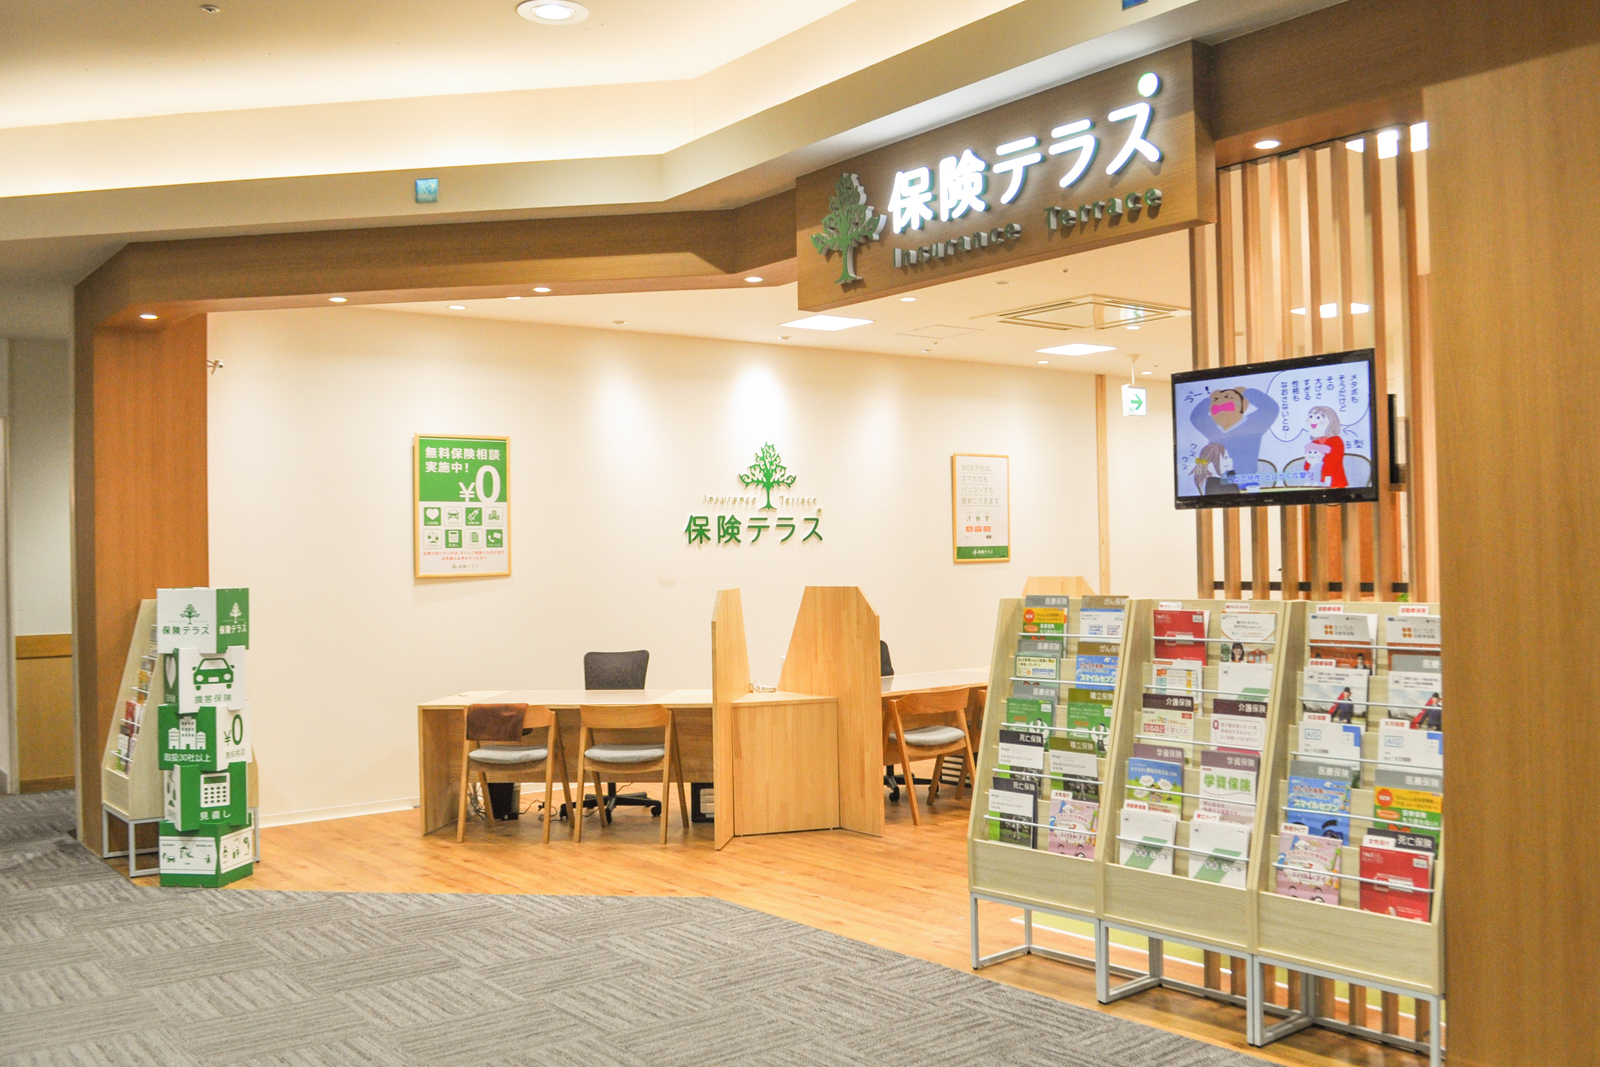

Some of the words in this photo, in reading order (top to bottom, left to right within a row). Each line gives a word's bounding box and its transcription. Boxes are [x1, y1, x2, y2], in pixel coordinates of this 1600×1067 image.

[887, 102, 1161, 234] 保険テラス
[893, 222, 1021, 268] Insurance
[1043, 188, 1163, 230] Terrace
[425, 446, 500, 460] 無料保険相談
[425, 461, 469, 474] 実施中!
[458, 465, 501, 502] ¥0
[962, 476, 988, 484] スマホでも
[962, 486, 994, 494] パソコンでも
[685, 514, 823, 544] 保険テラス
[1045, 597, 1068, 606] 医療保険
[162, 626, 210, 635] 保険テラス
[219, 624, 248, 635] 保険テラス
[1166, 698, 1192, 708] 介護保険
[1238, 703, 1266, 714] 介護保険
[224, 714, 244, 746] ¥0
[1213, 720, 1220, 730] Q
[1019, 734, 1042, 744] 死亡保険
[1070, 741, 1094, 751] 積立保険
[1318, 766, 1349, 778] 医療保険
[1012, 782, 1036, 792] 死亡保険
[1204, 774, 1251, 792] 学資保険
[1405, 775, 1440, 788] 医療保険
[1293, 798, 1340, 812] スマイルセブン
[200, 810, 231, 820] 見直し
[1398, 834, 1433, 849] 死亡保険
